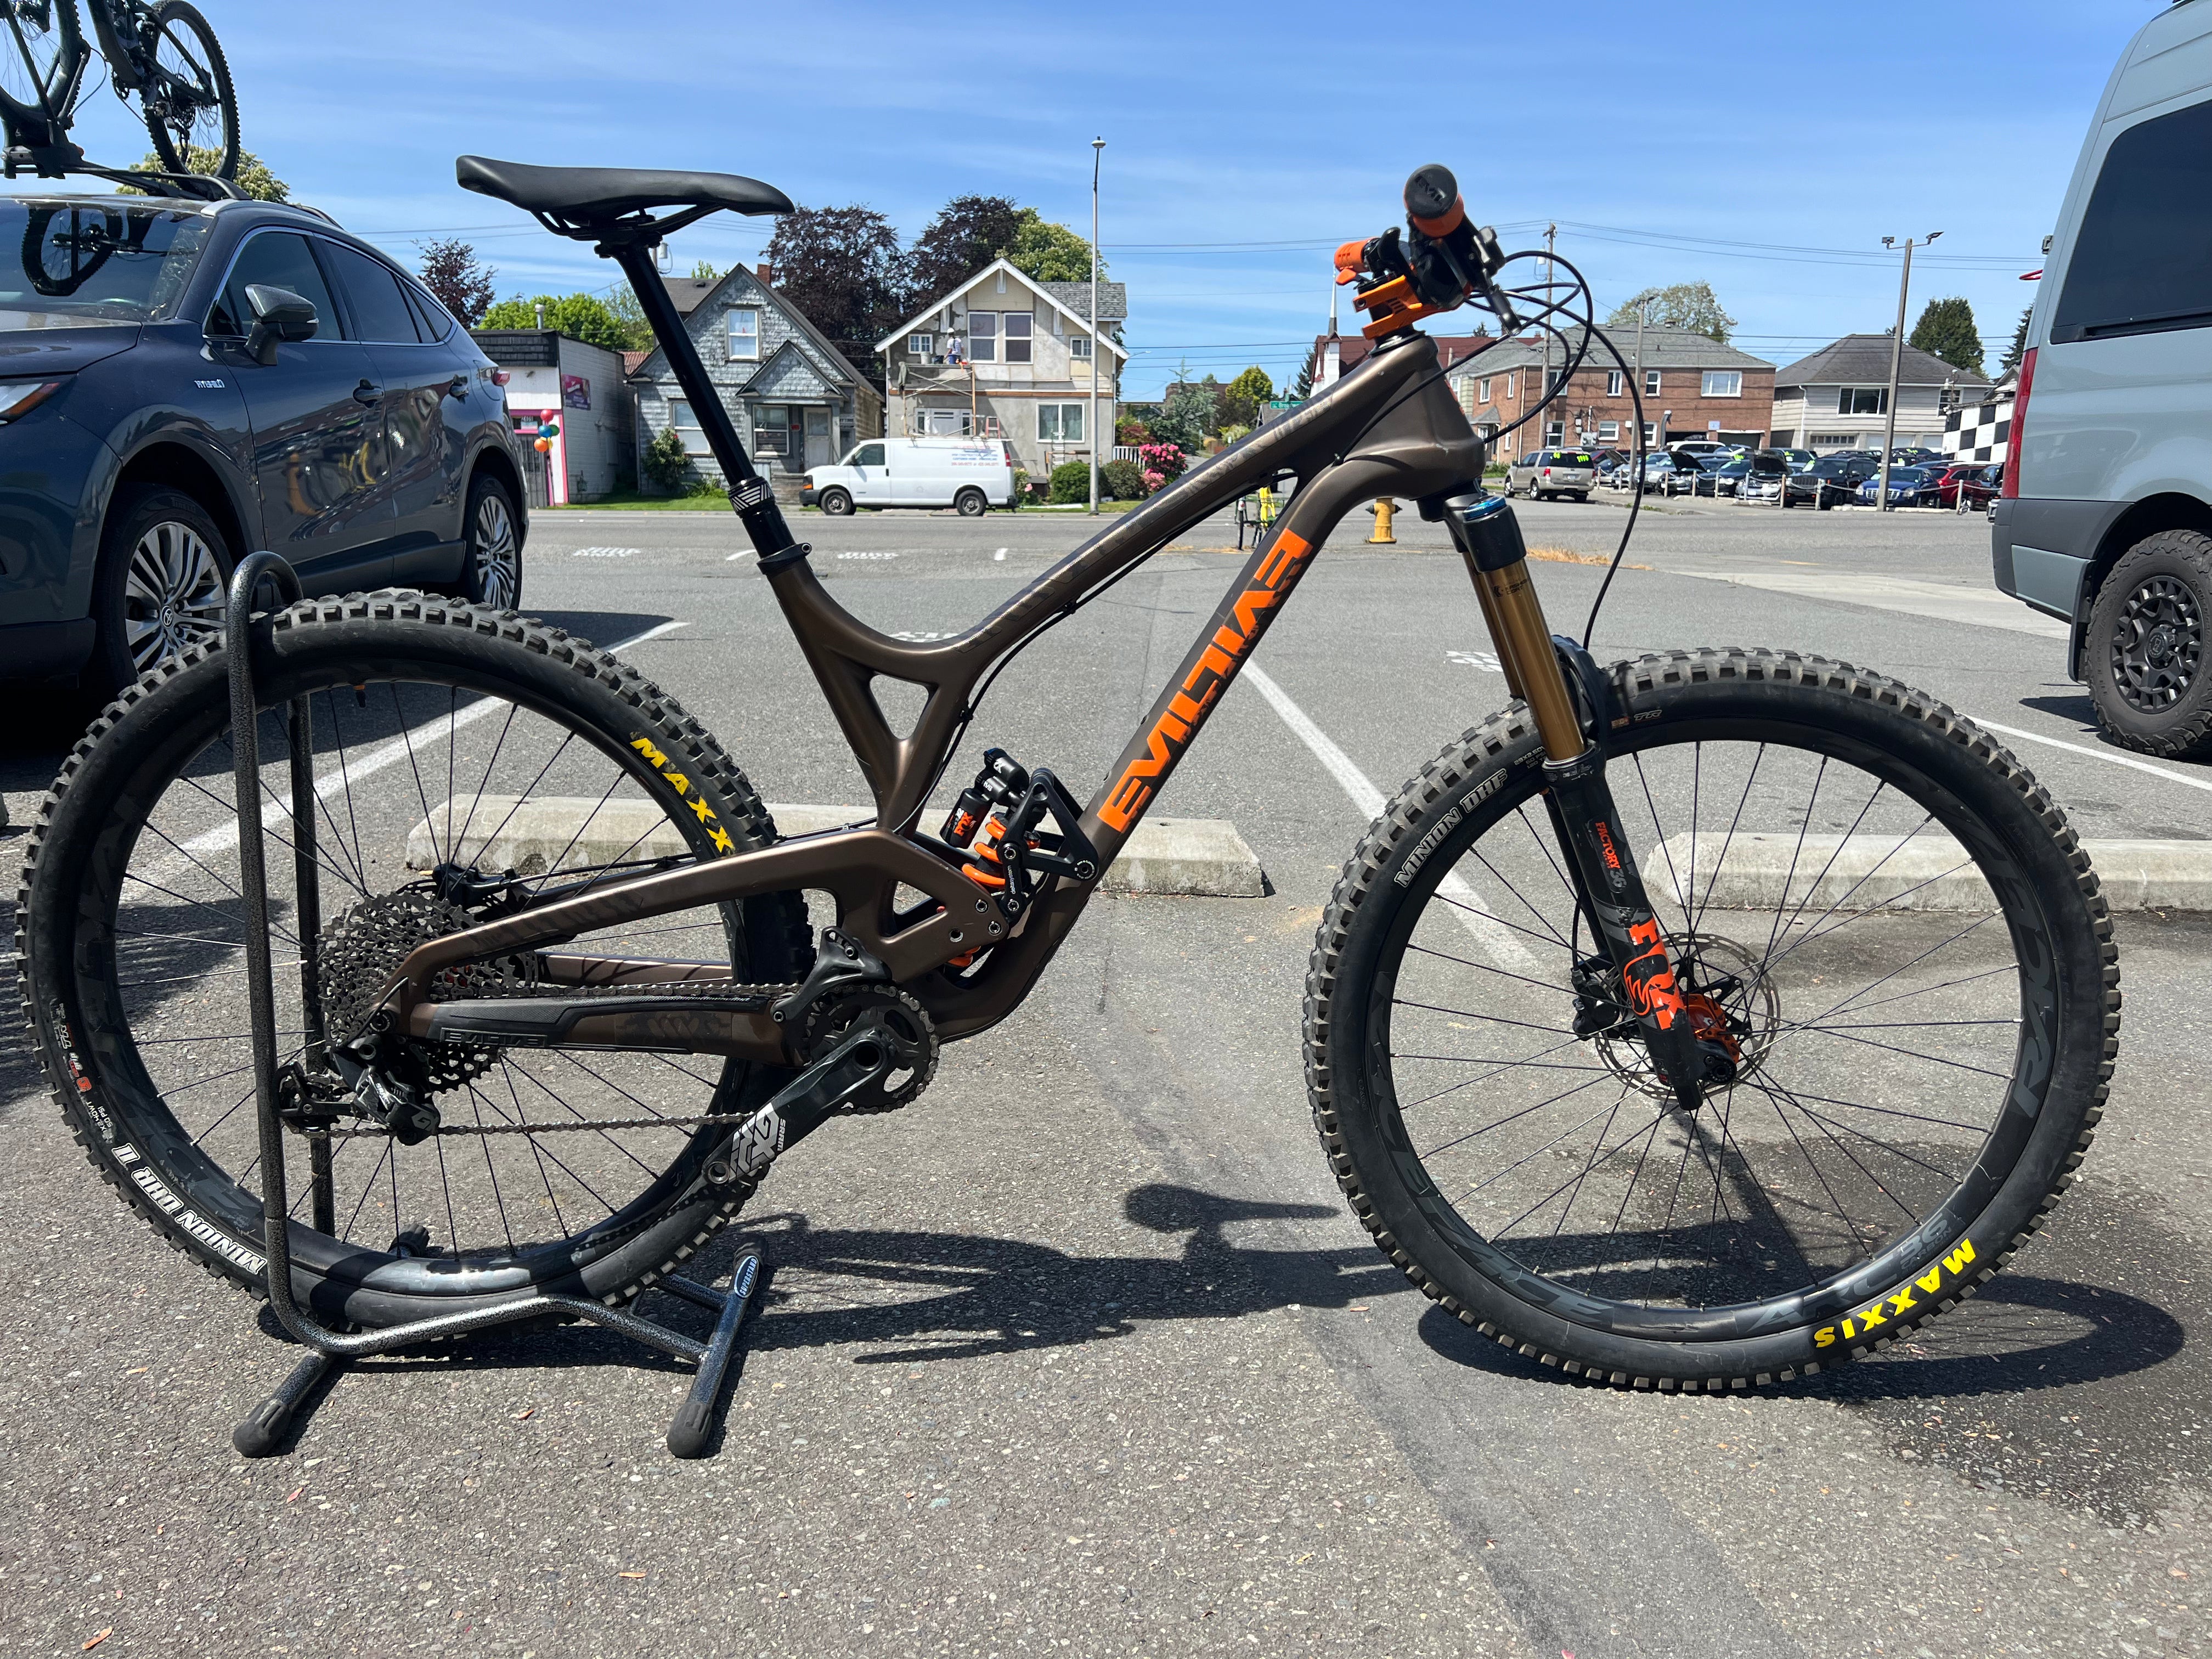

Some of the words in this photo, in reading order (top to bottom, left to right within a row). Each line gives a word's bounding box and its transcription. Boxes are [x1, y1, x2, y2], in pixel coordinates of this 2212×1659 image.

[1393, 807, 1462, 888] MINION
[1459, 768, 1508, 813] DHF
[1594, 821, 1621, 869] FACTORY
[1608, 867, 1628, 890] 36
[777, 1119, 787, 1152] SRAM
[131, 1167, 184, 1215] DHR
[174, 1209, 268, 1275] MINION
[740, 1258, 757, 1295] SUPERSTAND
[1814, 1238, 1976, 1348] MAXXIS
